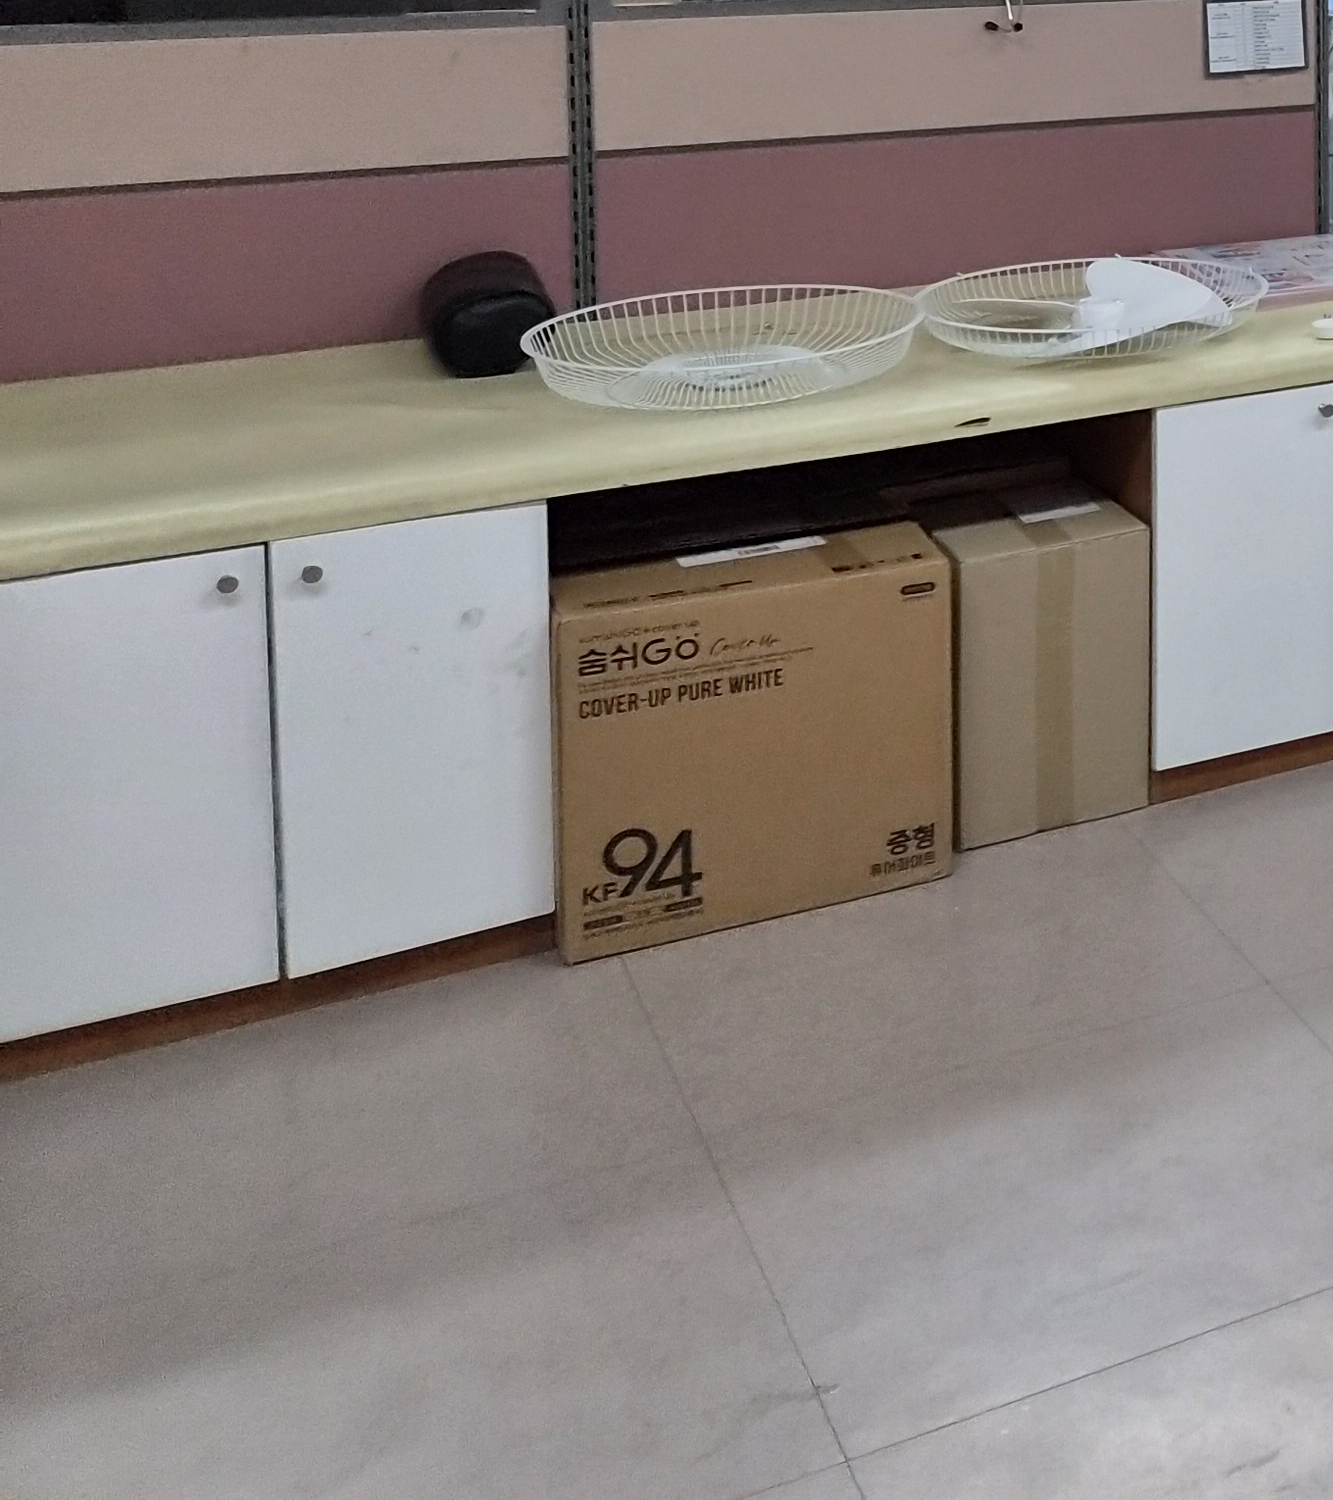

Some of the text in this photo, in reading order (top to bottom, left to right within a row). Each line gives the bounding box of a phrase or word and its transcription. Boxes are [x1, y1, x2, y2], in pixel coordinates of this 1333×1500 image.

[579, 687, 672, 720] COVER-UP
[677, 678, 724, 703] PURE
[728, 667, 784, 695] WHITE
[886, 822, 936, 855] 중형
